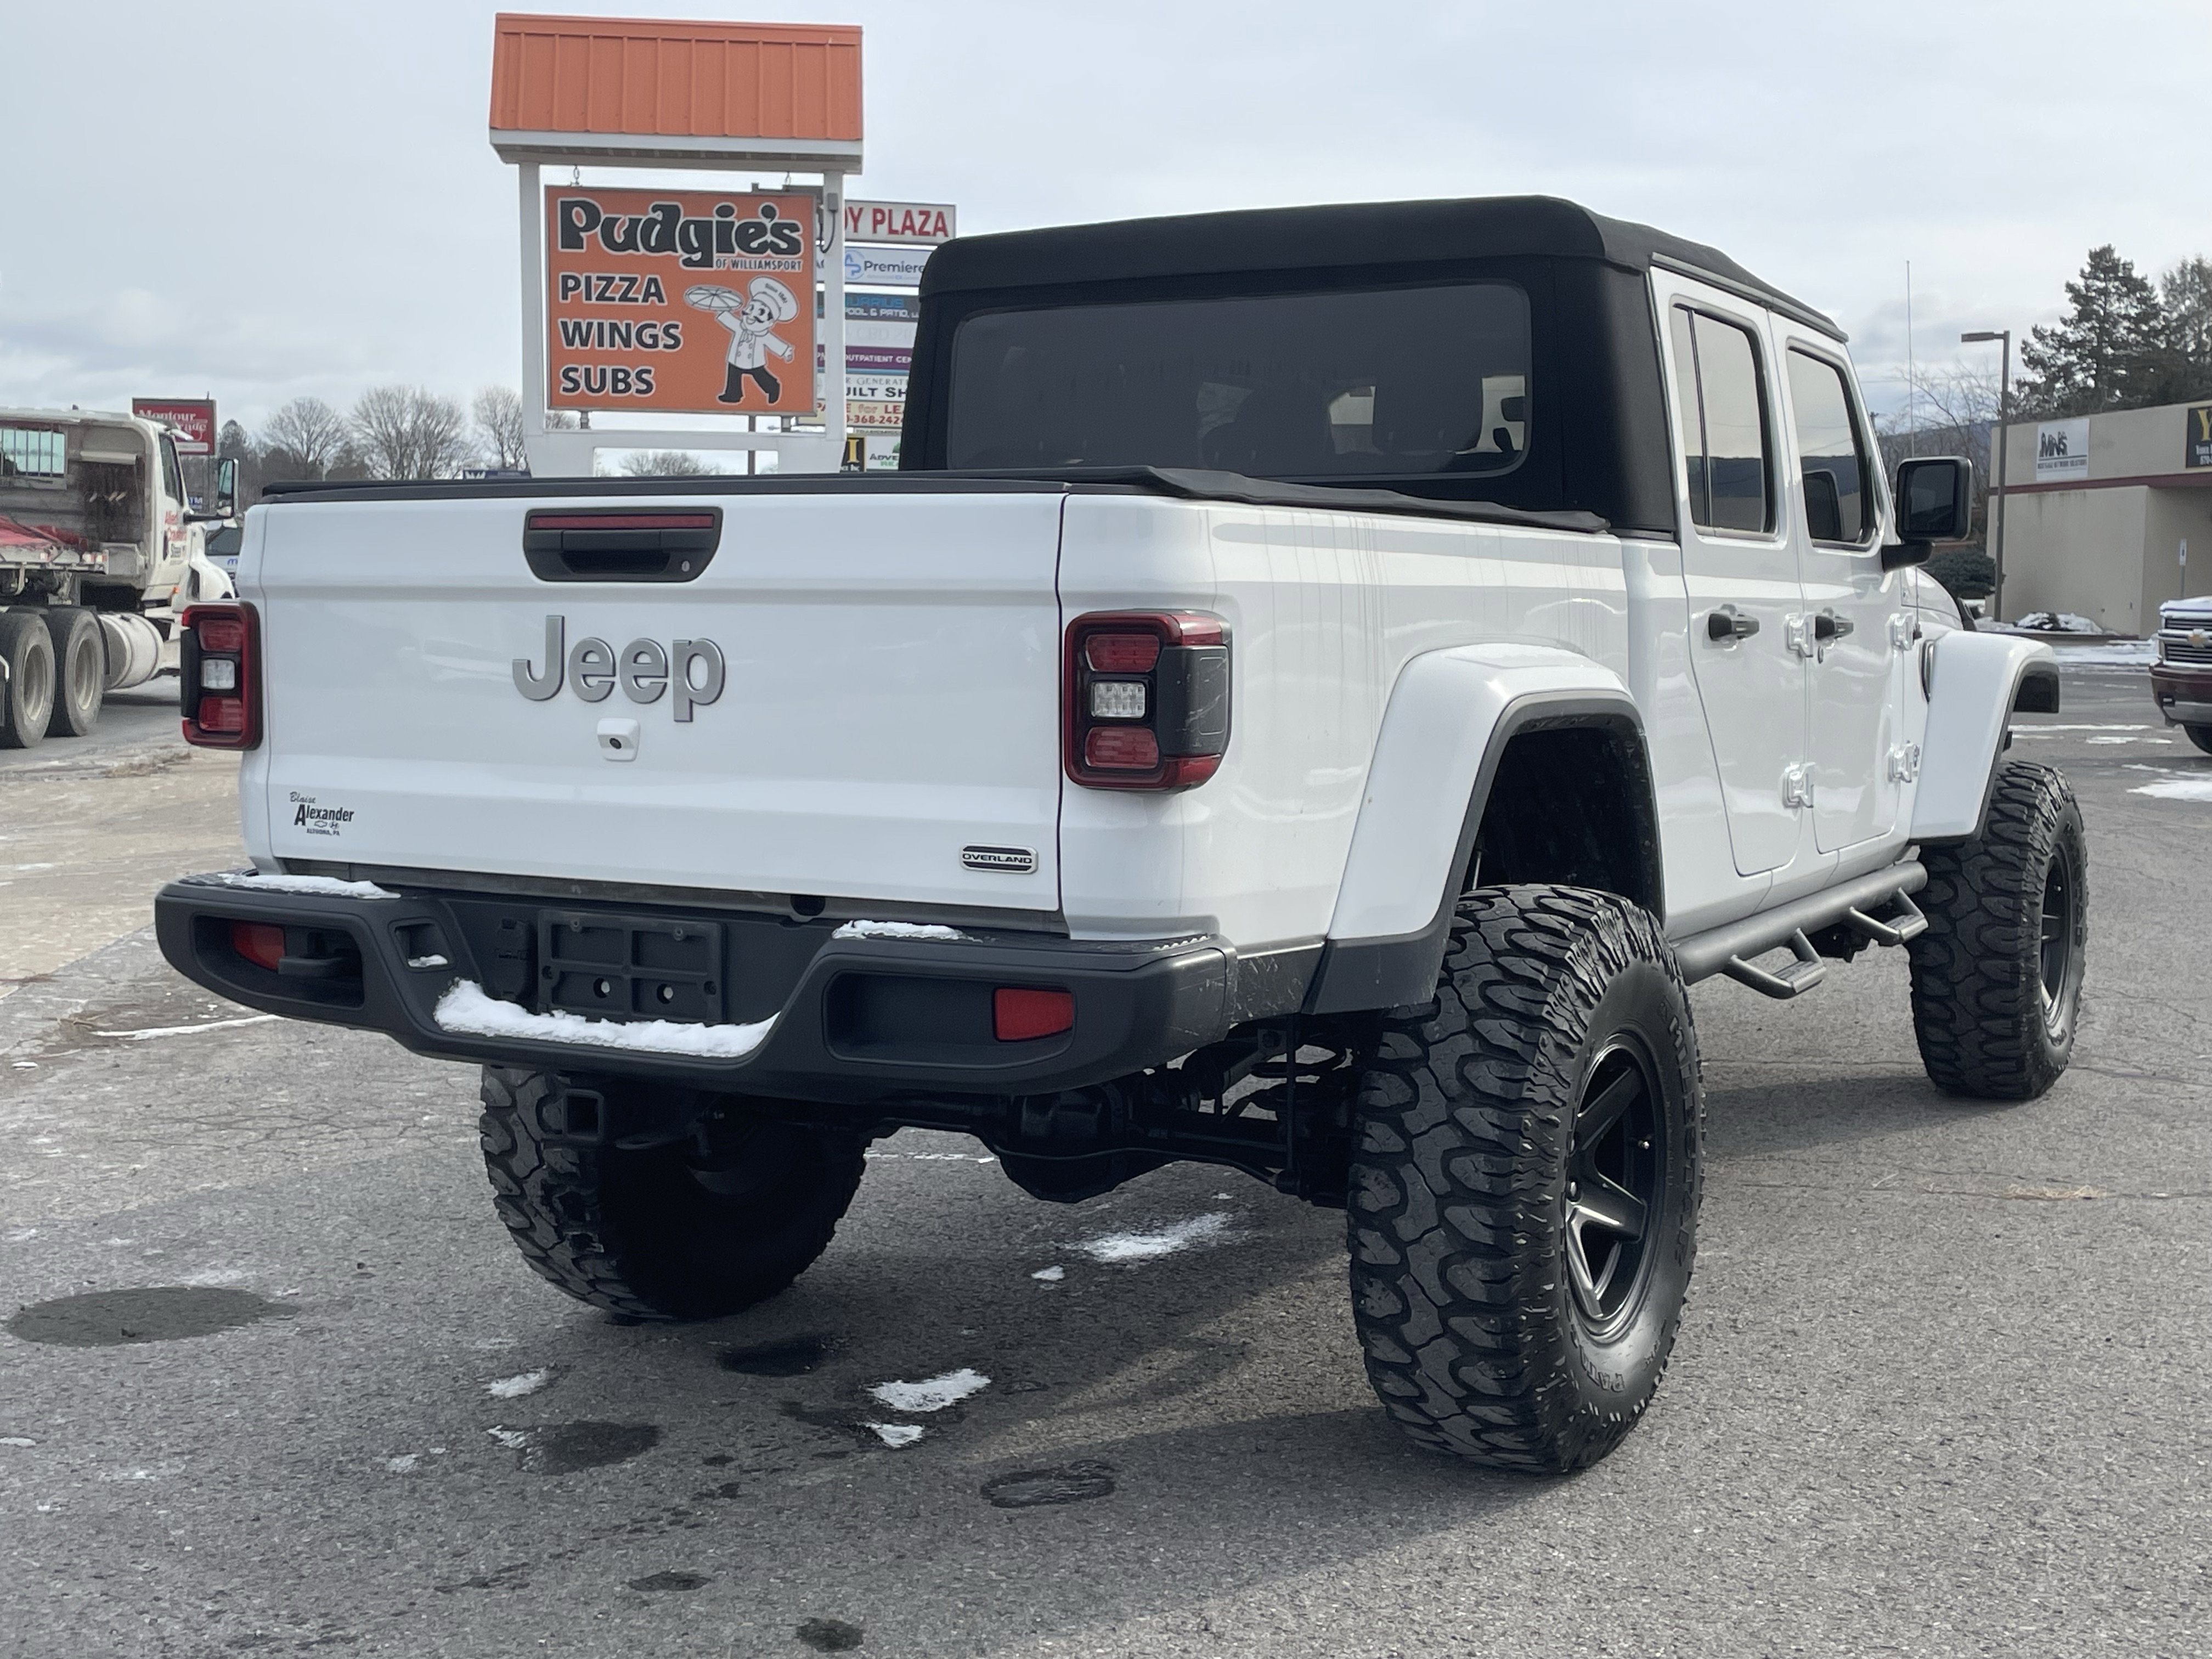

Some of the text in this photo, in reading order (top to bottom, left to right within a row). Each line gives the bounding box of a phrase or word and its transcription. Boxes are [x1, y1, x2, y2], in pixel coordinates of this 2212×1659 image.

[560, 199, 802, 269] Pudgie's
[872, 207, 949, 237] PLAZA
[715, 258, 727, 269] OF
[730, 258, 802, 272] WILLIAMSPORT
[560, 274, 665, 303] PIZZA
[560, 321, 682, 350] WINGS
[560, 366, 654, 394] SUBS
[845, 387, 907, 398] UILT SH
[857, 377, 909, 385] GENERAT
[858, 404, 878, 414] for
[884, 404, 903, 414] LE
[512, 614, 726, 723] Jeep
[294, 804, 354, 826] Alexander
[962, 853, 1032, 864] OVERLAND
